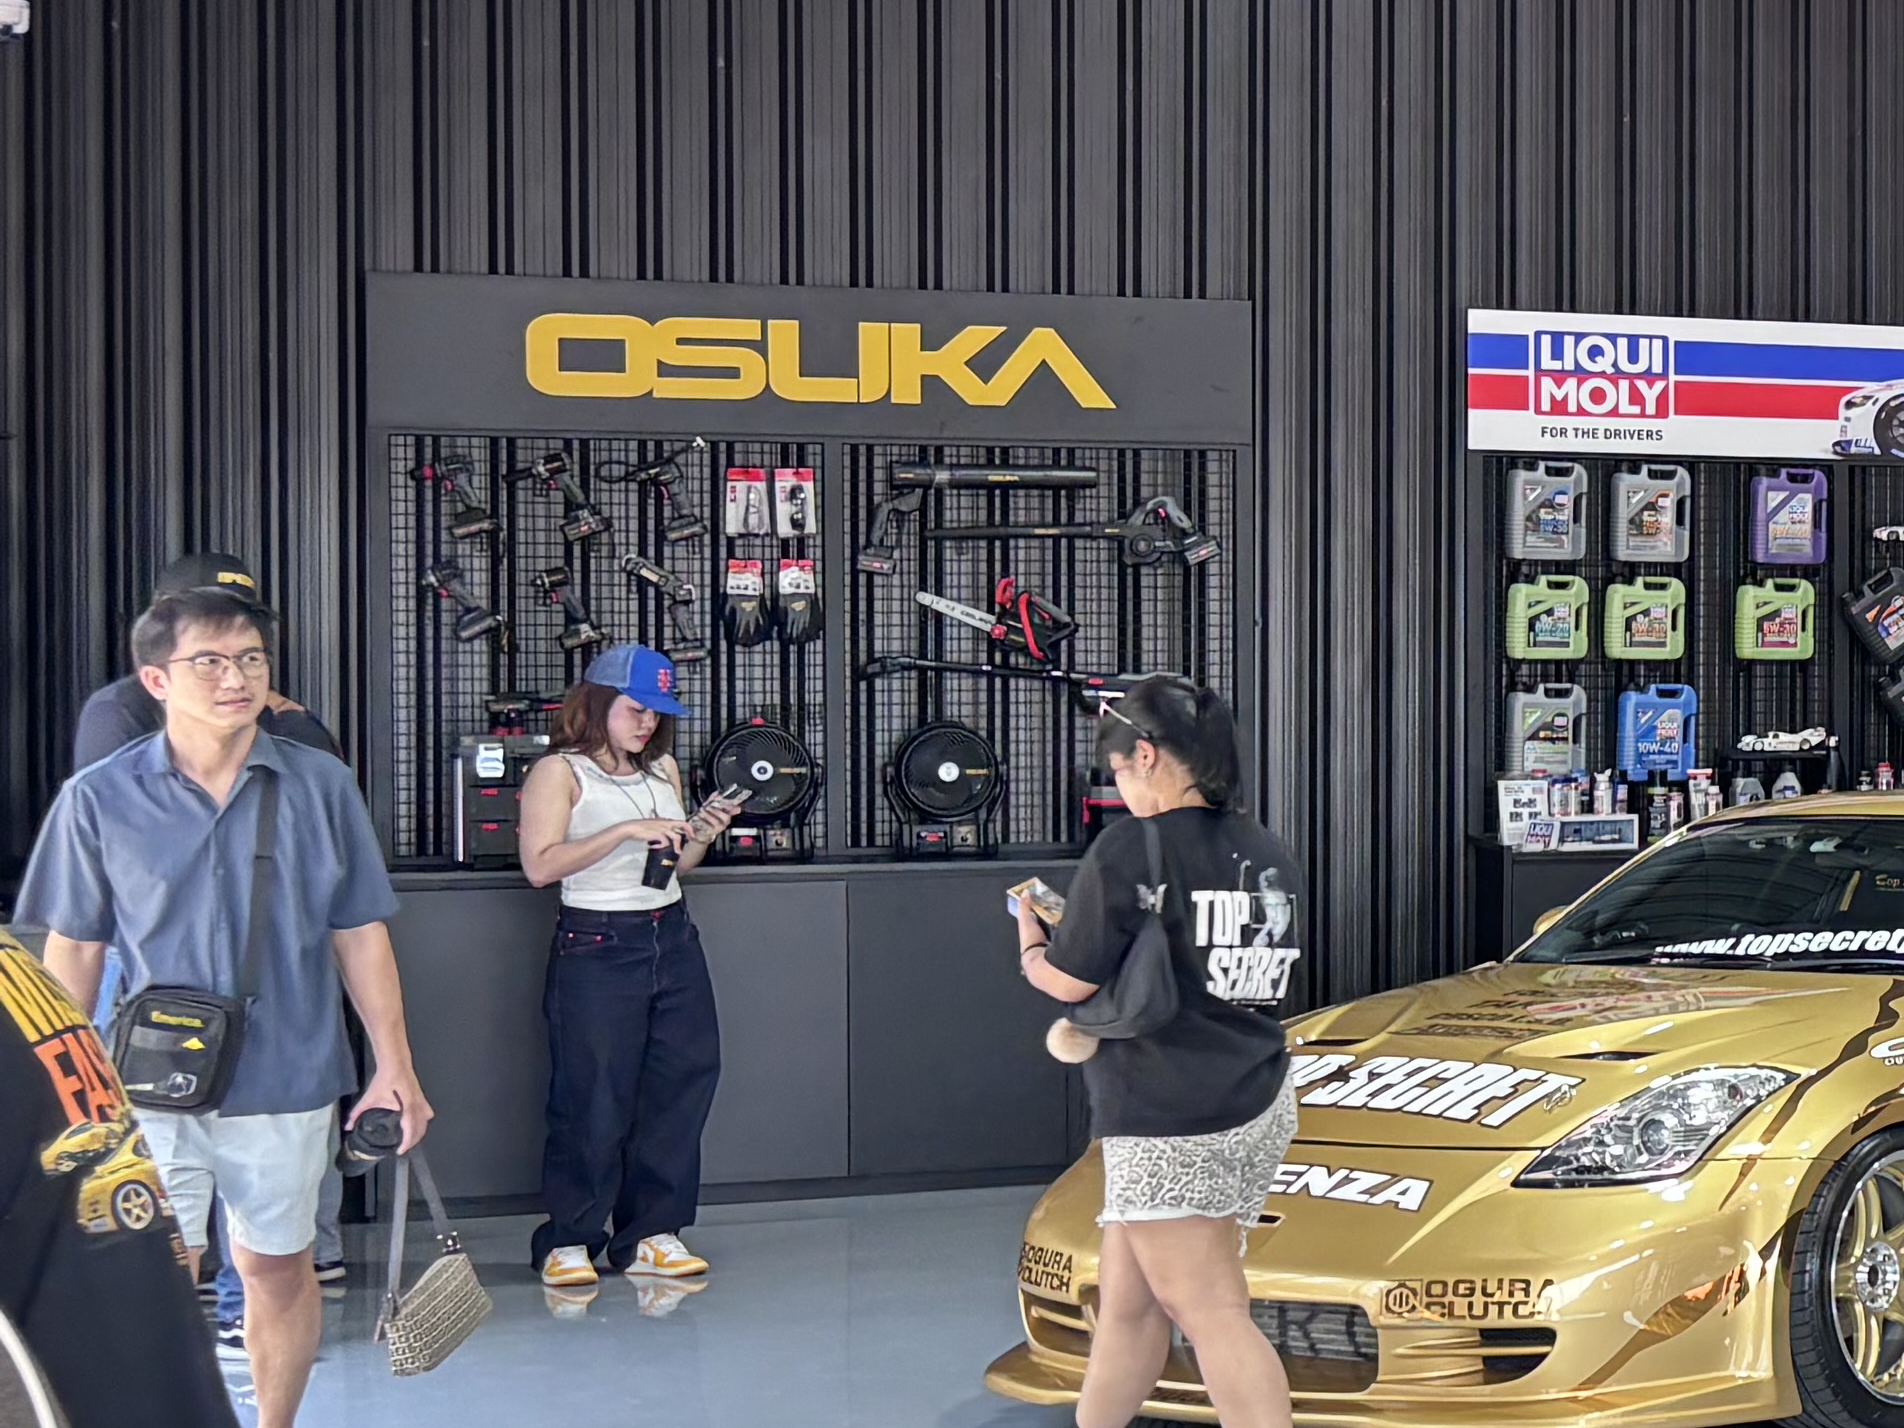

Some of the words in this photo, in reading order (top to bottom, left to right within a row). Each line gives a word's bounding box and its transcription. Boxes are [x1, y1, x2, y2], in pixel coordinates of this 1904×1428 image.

[525, 312, 1117, 410] OSUKA
[1540, 334, 1663, 375] LIQUI
[1540, 376, 1668, 415] MOLY
[1541, 426, 1568, 439] FOR
[1572, 427, 1600, 440] THE
[1603, 428, 1664, 441] DRIVERS
[1637, 741, 1680, 754] 10W-40
[1191, 890, 1250, 947] TOP
[1206, 947, 1301, 1001] SECRET
[1299, 1055, 1588, 1129] SECRET
[1027, 1243, 1074, 1274] OGURA
[1423, 1277, 1557, 1300] OGURA
